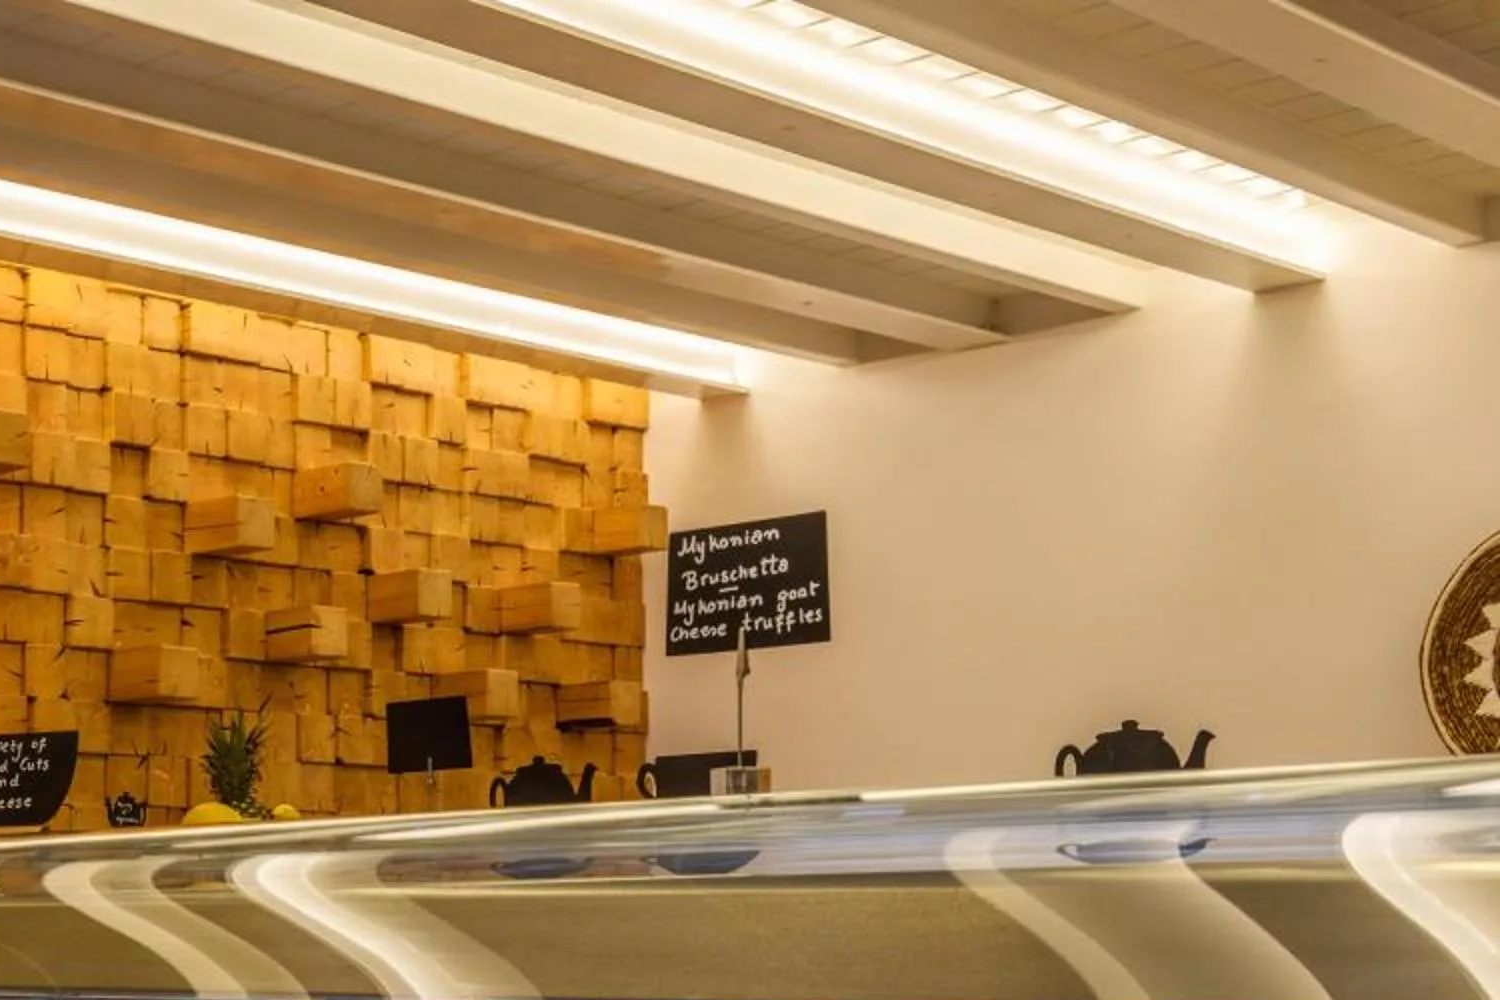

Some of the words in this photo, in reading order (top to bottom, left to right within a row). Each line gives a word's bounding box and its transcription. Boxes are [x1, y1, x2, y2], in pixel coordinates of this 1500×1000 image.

[677, 528, 780, 564] Mykonian
[682, 554, 789, 591] Bruschetta
[674, 594, 763, 626] Mykonian
[777, 580, 820, 612] goat
[741, 608, 823, 634] truffles
[31, 737, 48, 752] of
[20, 757, 50, 771] Cuts
